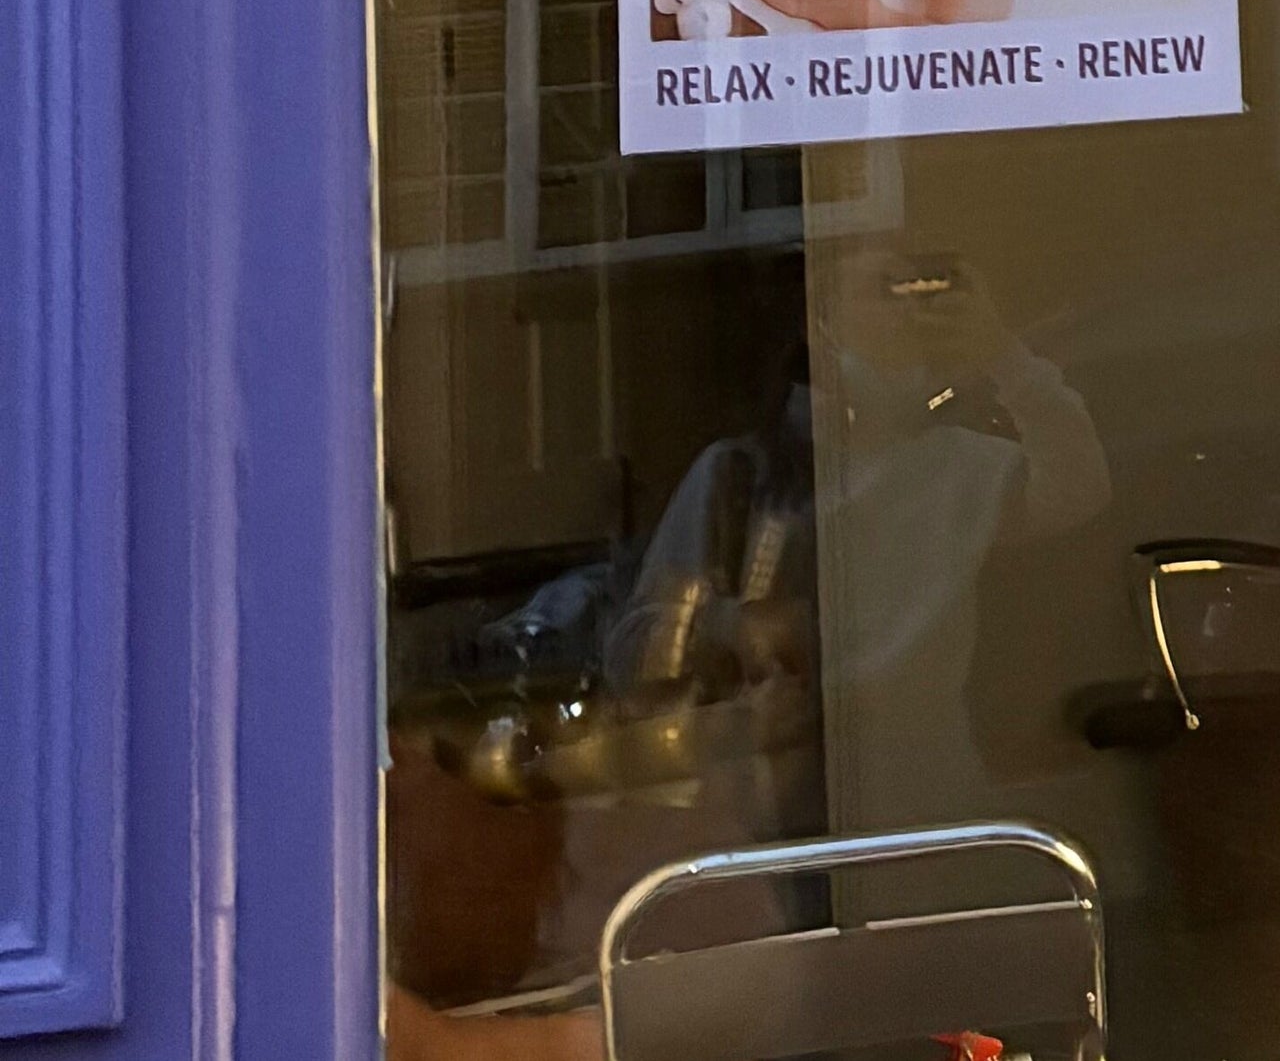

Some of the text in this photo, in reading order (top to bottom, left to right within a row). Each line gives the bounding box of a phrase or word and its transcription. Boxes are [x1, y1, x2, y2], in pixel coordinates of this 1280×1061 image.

[655, 35, 1206, 108] RELAX REJUVENATE RENEW
